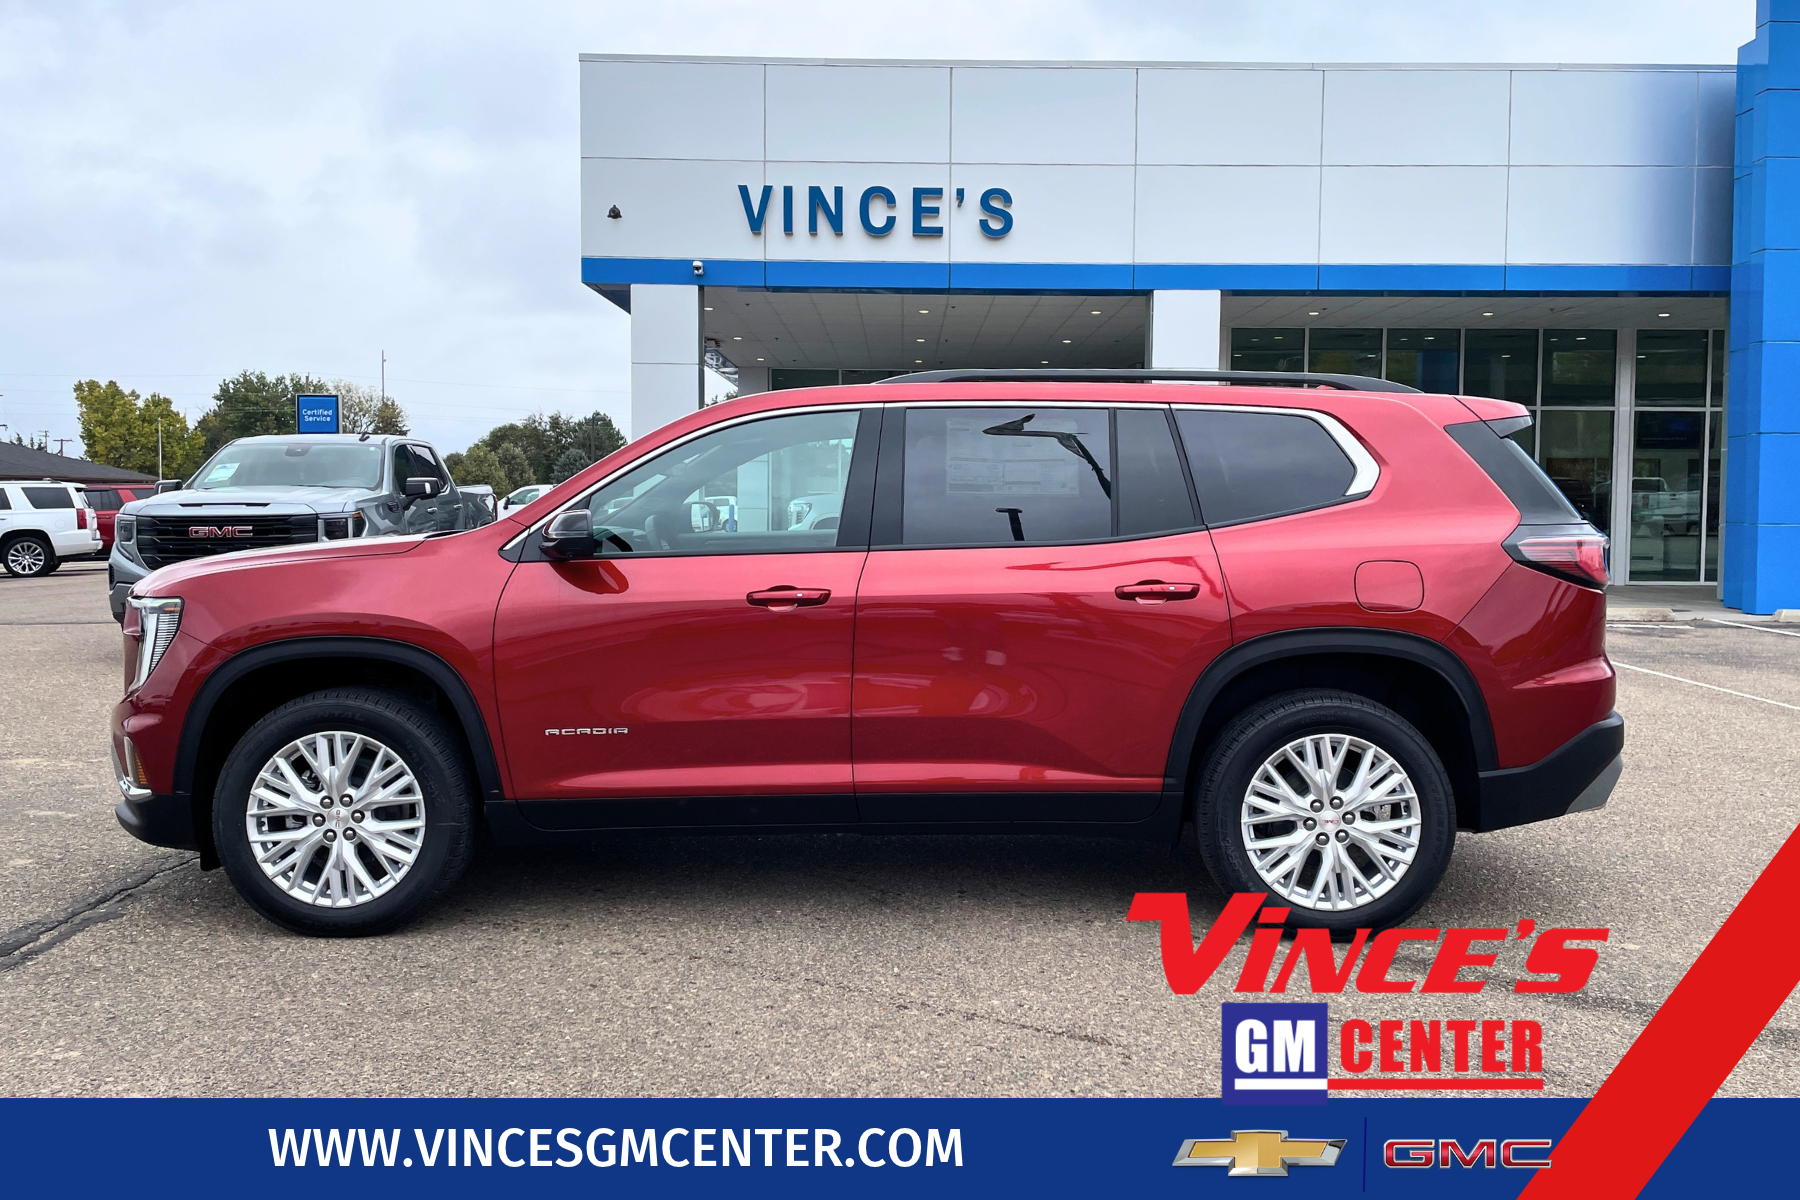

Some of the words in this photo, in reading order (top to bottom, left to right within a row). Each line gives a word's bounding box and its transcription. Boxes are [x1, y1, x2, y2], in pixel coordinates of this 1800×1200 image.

[738, 184, 1014, 238] VINCE'S
[188, 526, 253, 538] GMC
[545, 727, 629, 736] ACADIA
